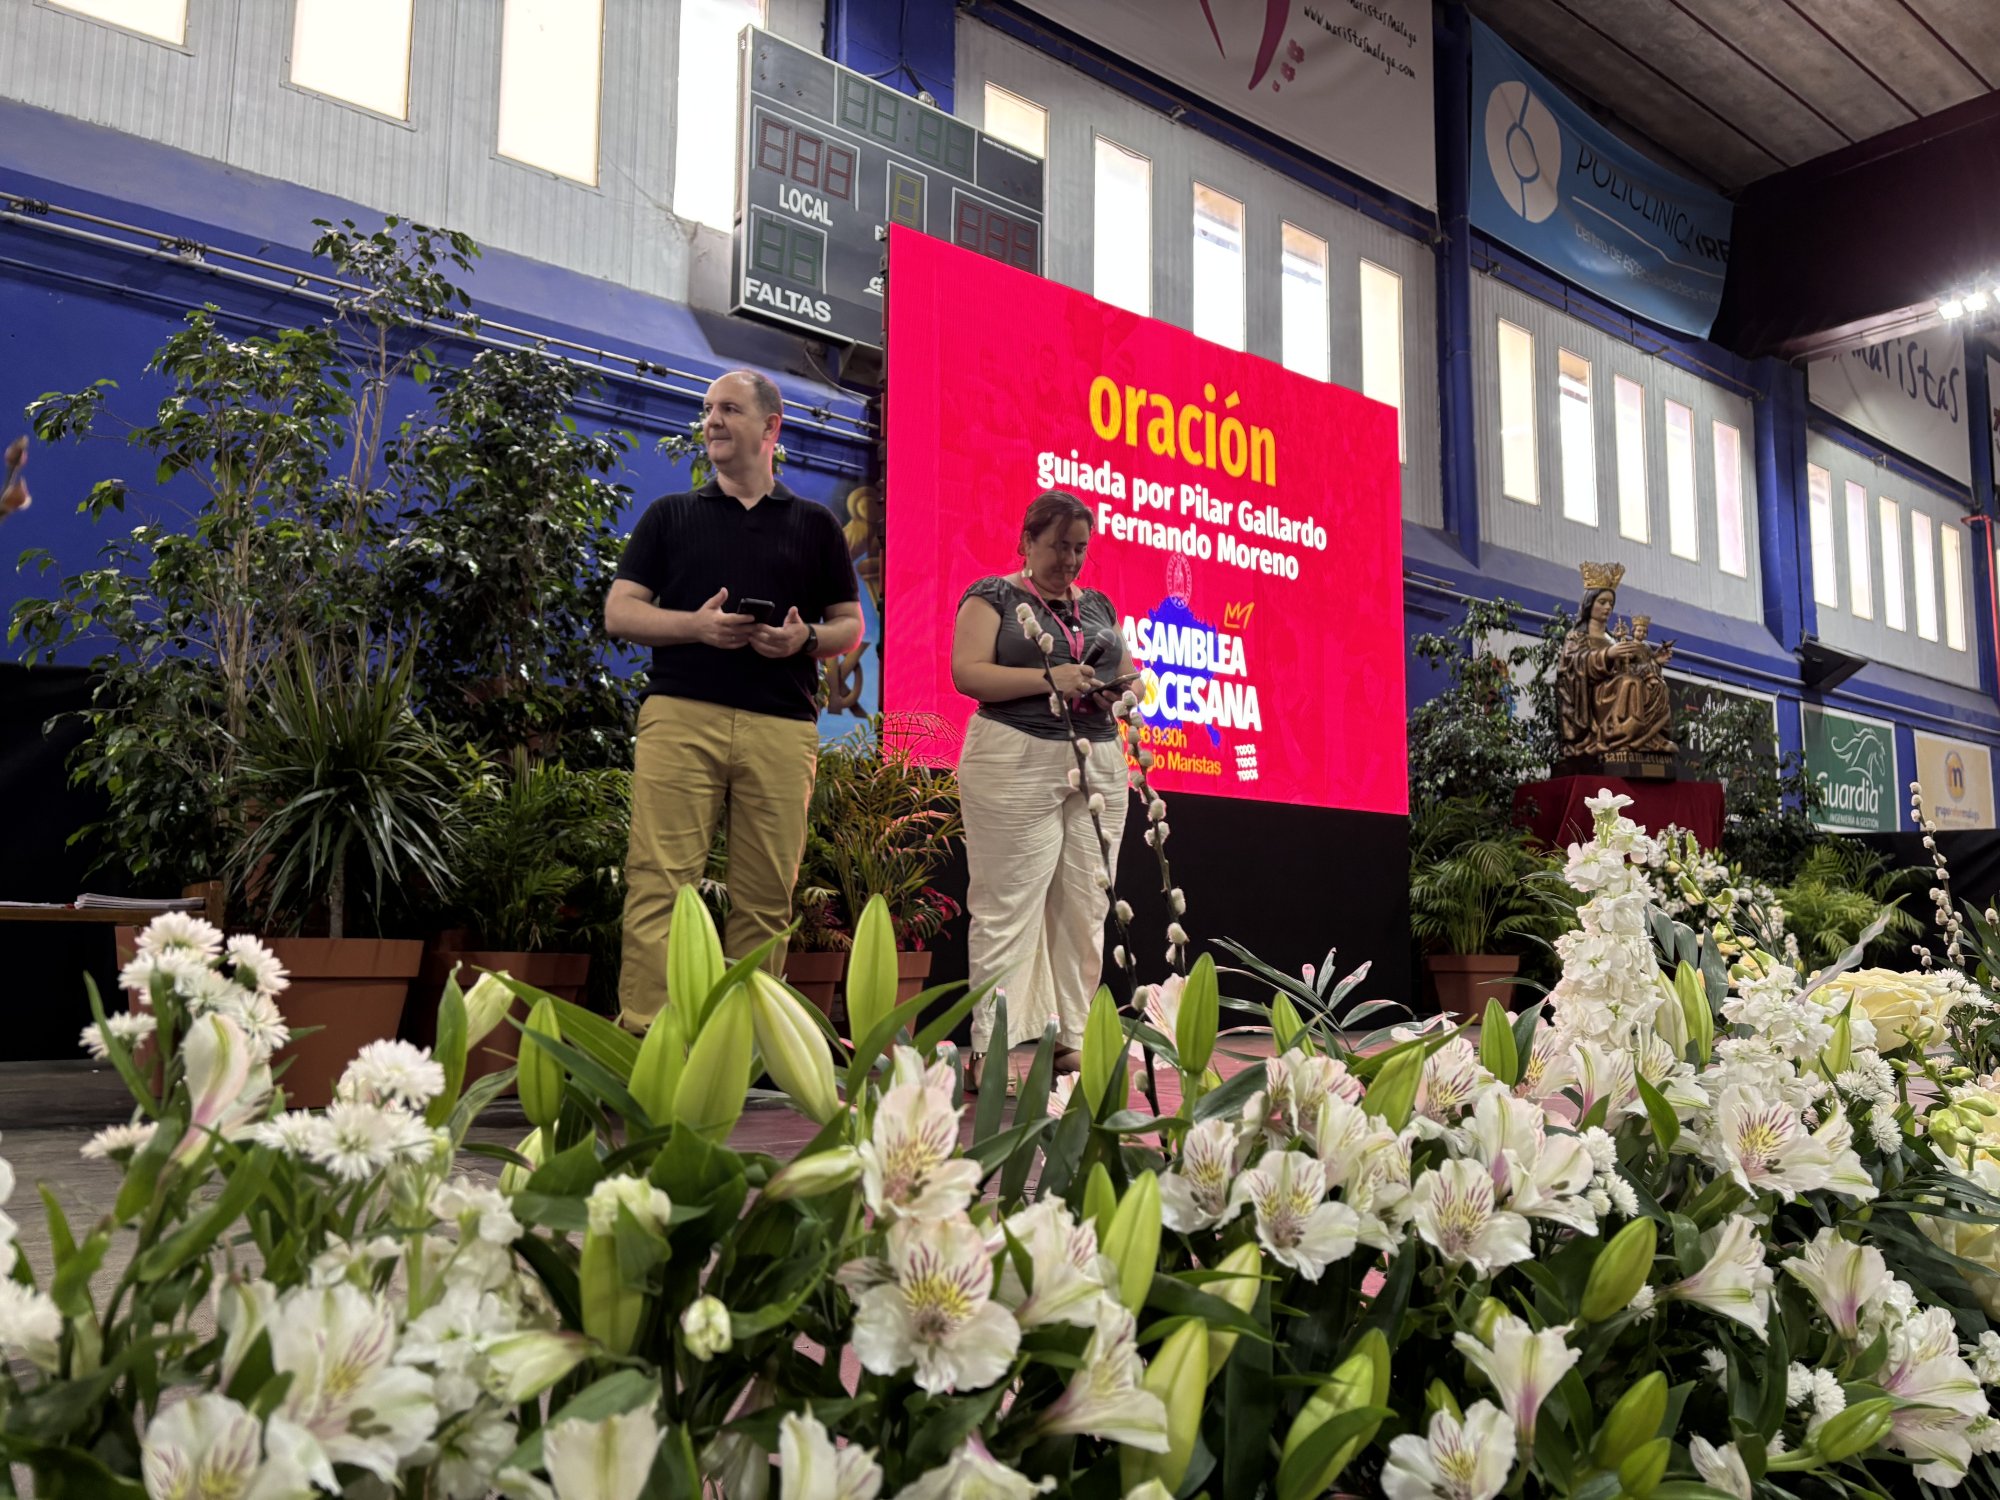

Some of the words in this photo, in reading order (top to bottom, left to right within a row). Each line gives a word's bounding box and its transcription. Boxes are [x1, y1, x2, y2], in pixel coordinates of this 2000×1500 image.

[778, 183, 833, 226] LOCAL
[745, 277, 831, 323] FALTAS
[1089, 375, 1276, 487] oración
[1037, 449, 1126, 500] guiada
[1132, 477, 1174, 513] por
[1180, 483, 1234, 526] Pilar
[1238, 500, 1327, 551] Gallardo
[1097, 502, 1212, 560] Fernando
[1217, 532, 1299, 580] Moreno
[1123, 615, 1247, 677] ASAMBLEA
[1152, 727, 1188, 749] 9:30h
[1234, 744, 1257, 757] TODOS
[1168, 751, 1222, 776] Maristas
[1235, 755, 1258, 769] TODOS
[1236, 768, 1259, 782] TODOS
